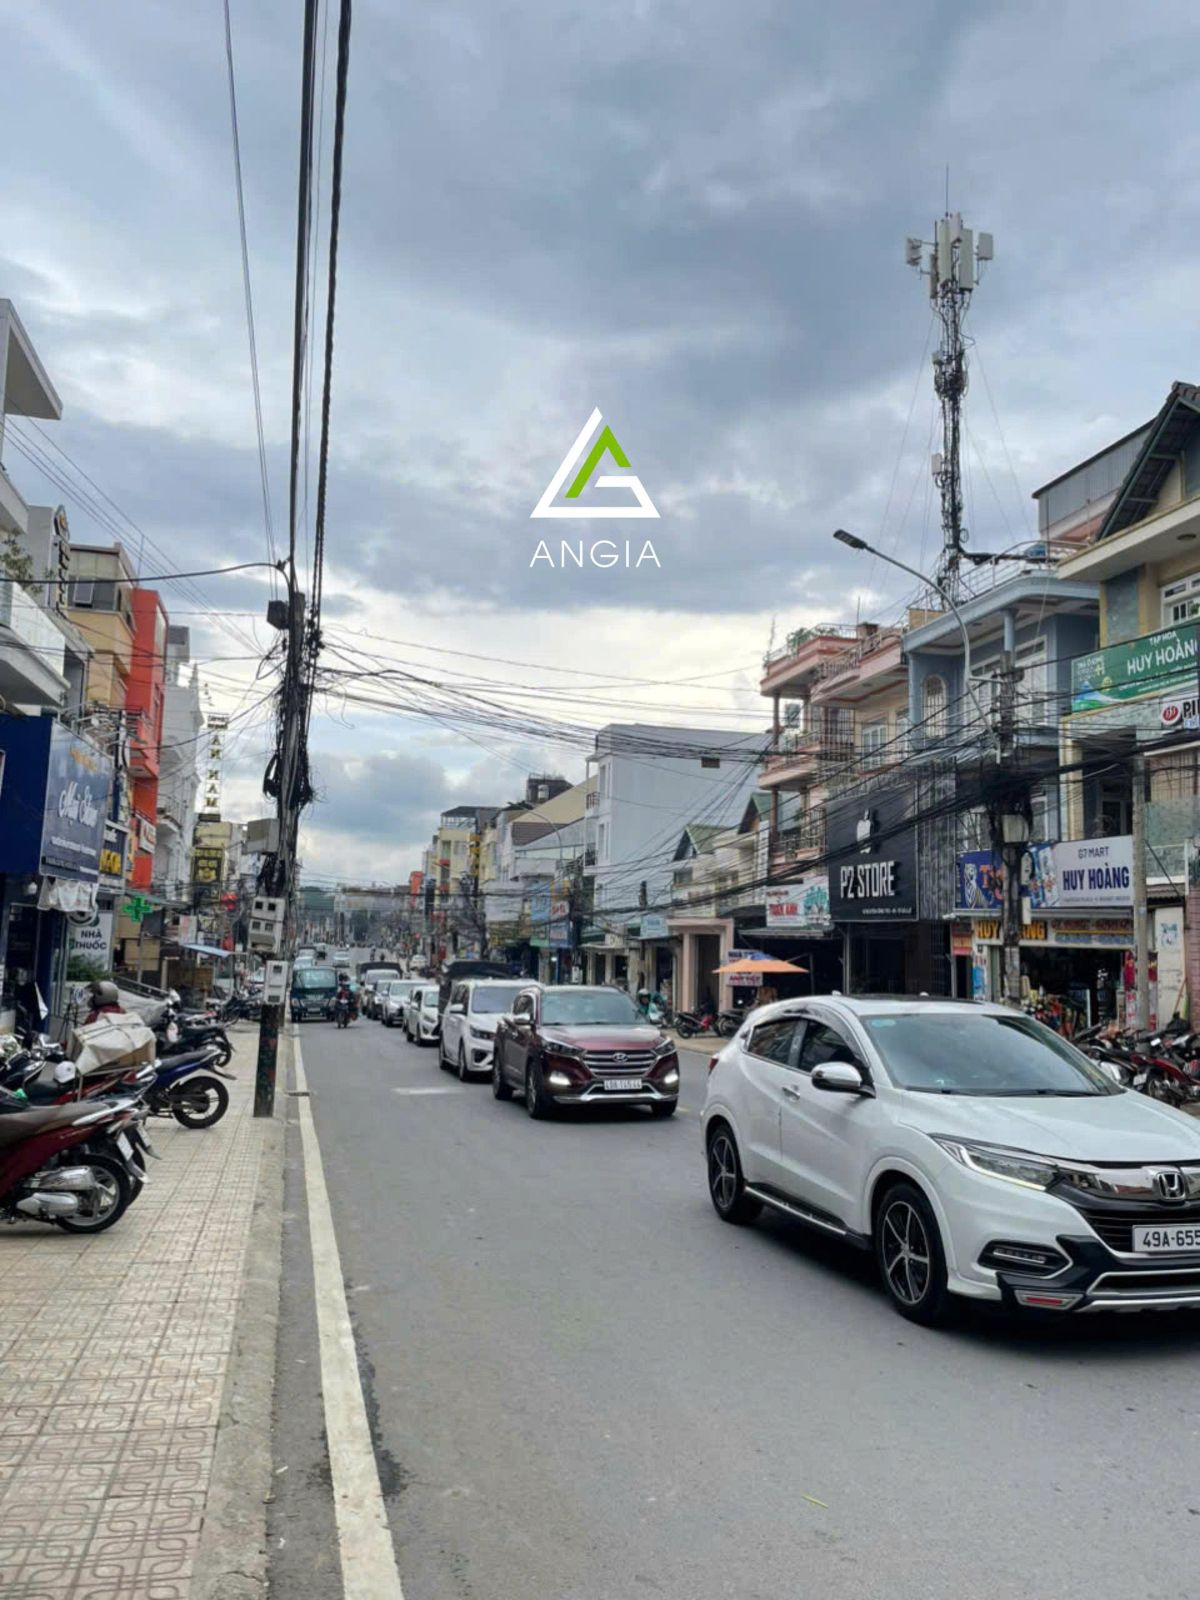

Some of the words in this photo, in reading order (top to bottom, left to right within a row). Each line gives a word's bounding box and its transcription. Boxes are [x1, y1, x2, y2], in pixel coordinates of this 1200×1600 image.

[1127, 651, 1153, 677] HUY
[1155, 637, 1198, 667] HOÀN
[1088, 846, 1109, 859] MART
[840, 865, 855, 899] P2
[857, 860, 895, 898] STORE
[1063, 869, 1085, 891] HUY
[1088, 861, 1130, 890] HOÀNG
[975, 919, 998, 940] HUY
[1143, 1229, 1200, 1248] 49A-655
